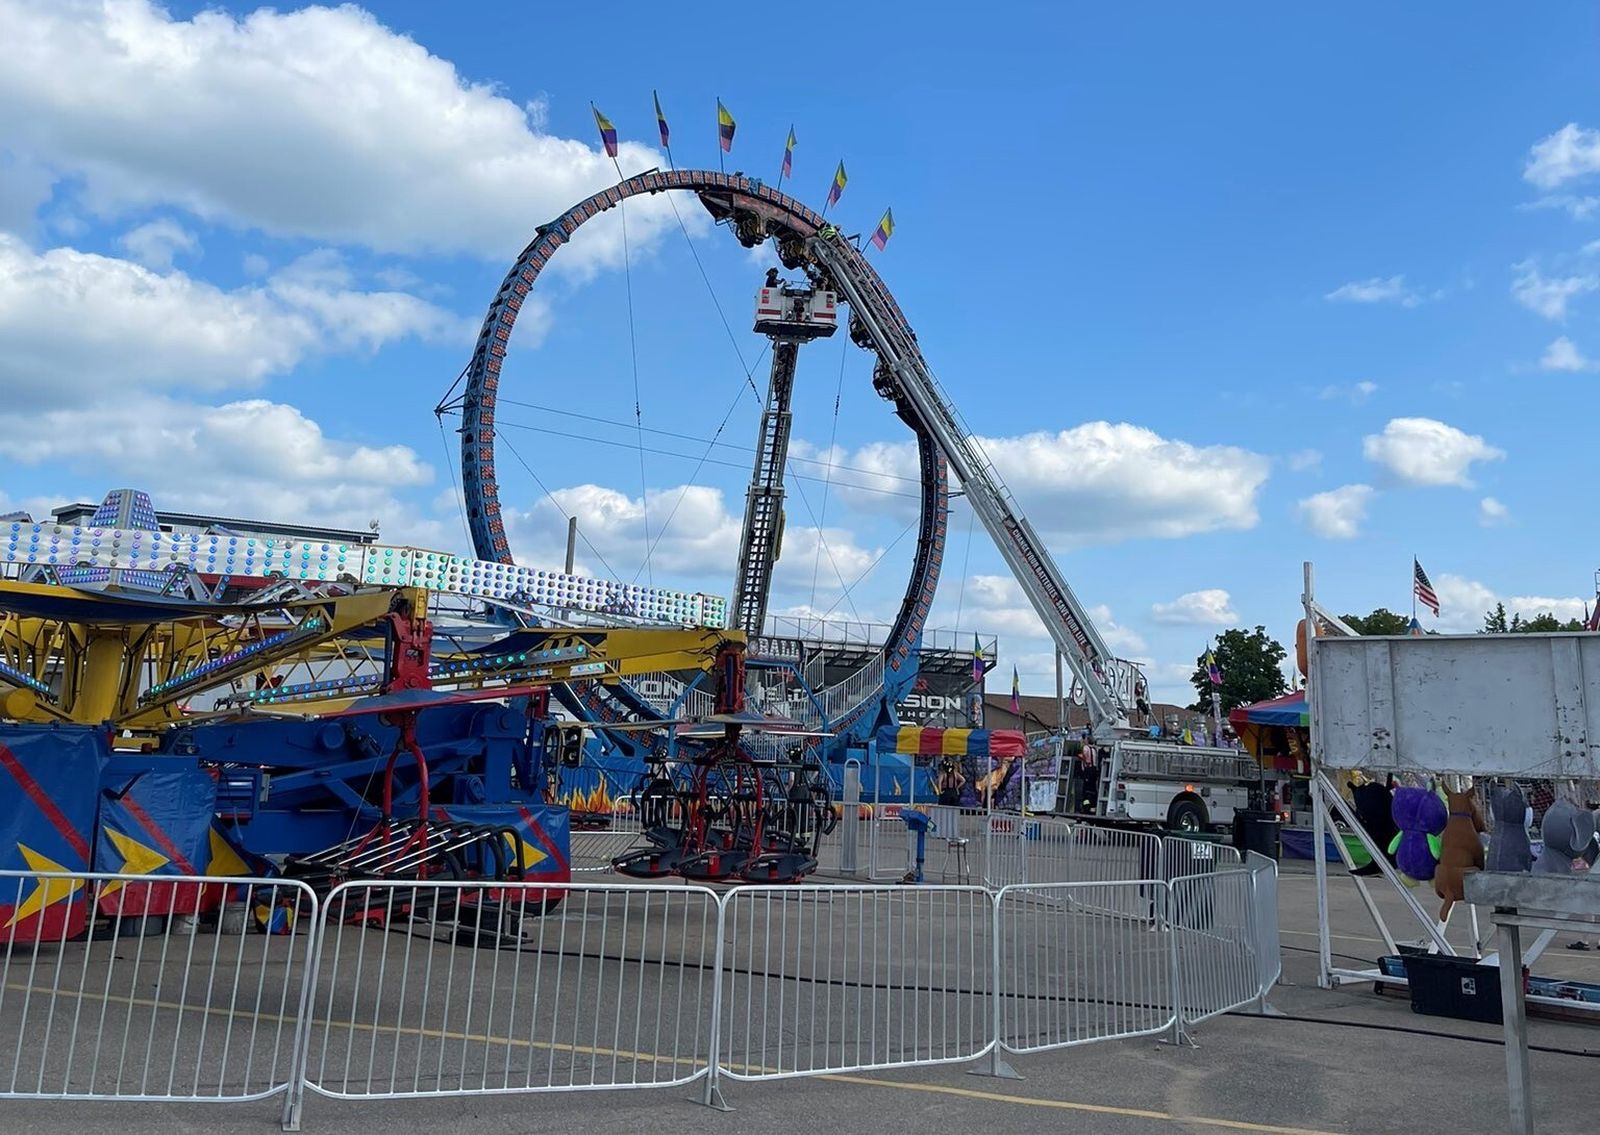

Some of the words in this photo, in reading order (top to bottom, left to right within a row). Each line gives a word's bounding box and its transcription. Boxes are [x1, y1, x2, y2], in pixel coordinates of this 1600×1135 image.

[1012, 528, 1031, 554] CHANGE
[1026, 550, 1040, 568] YOUR
[1034, 566, 1059, 599] BATTERIES
[1055, 600, 1070, 617] SAVE
[1064, 614, 1080, 633] YOUR
[1074, 631, 1088, 646] LIFE
[758, 637, 799, 658] BALL
[897, 694, 961, 710] SION
